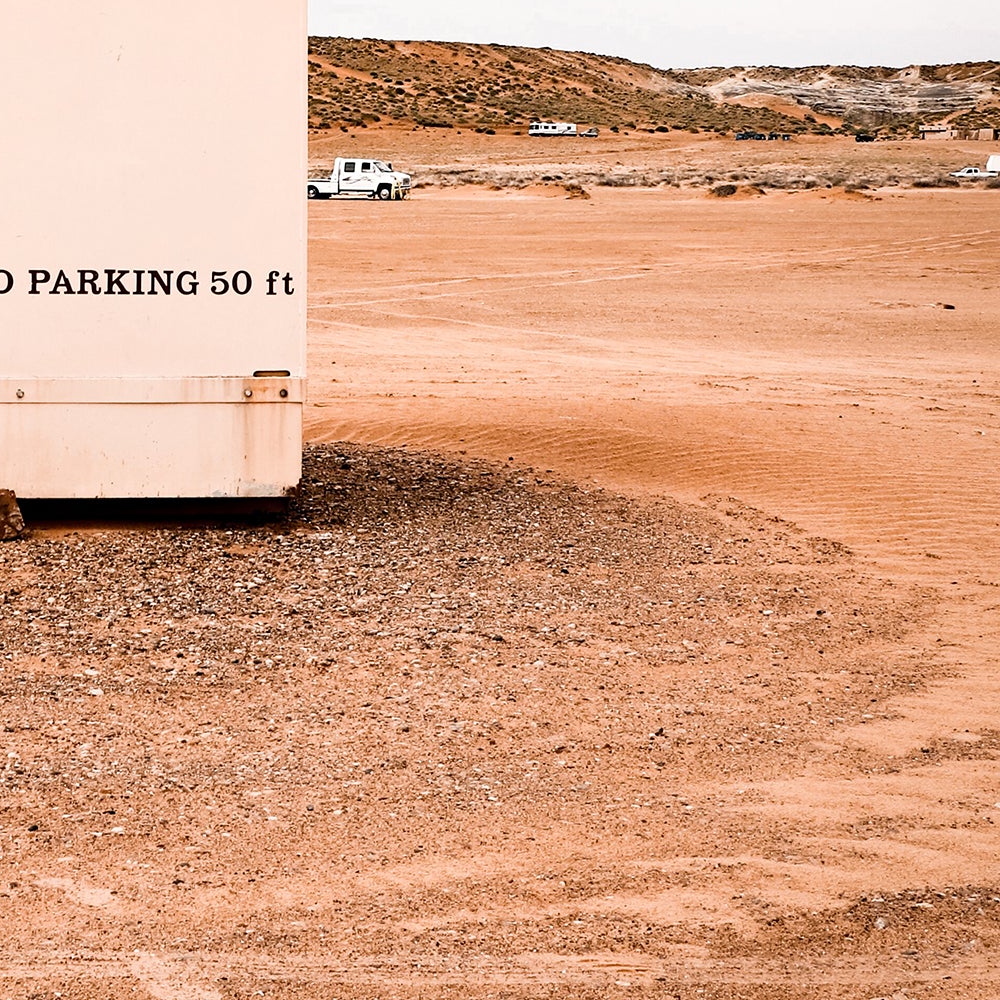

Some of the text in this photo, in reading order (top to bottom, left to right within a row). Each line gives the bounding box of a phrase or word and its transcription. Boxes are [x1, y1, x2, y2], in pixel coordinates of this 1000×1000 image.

[28, 269, 200, 296] PARKING
[210, 270, 253, 296] 50
[266, 270, 295, 296] ft
